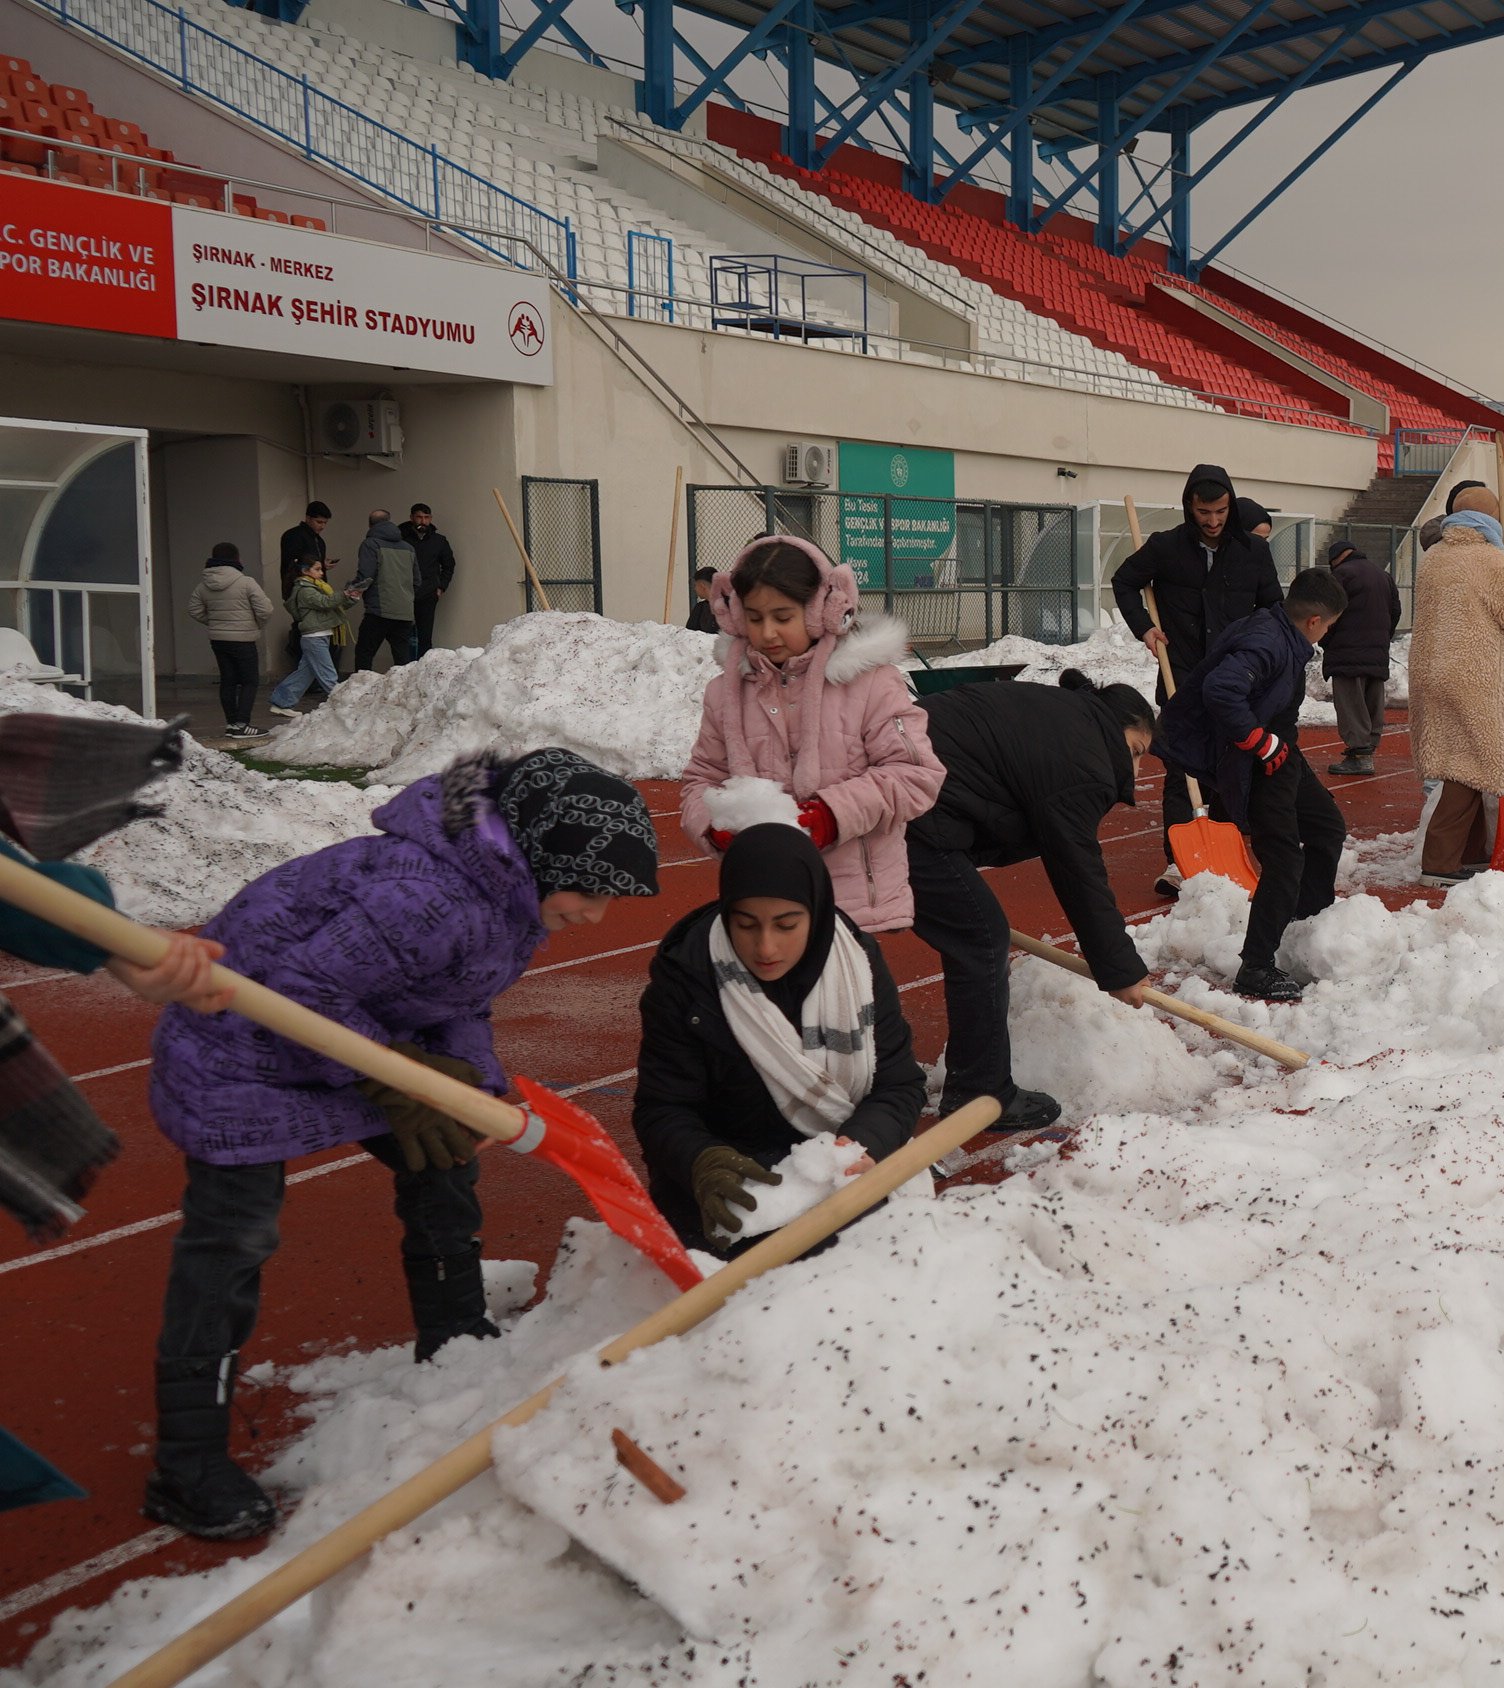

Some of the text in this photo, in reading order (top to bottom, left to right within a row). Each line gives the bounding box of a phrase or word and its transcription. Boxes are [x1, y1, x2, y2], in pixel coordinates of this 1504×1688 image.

[30, 228, 122, 260] GENÇLİK
[128, 244, 154, 265] VE
[192, 243, 256, 268] ŞIRNAK
[270, 256, 334, 281] MERKEZ
[48, 258, 156, 292] BAKANLIĞI
[191, 282, 475, 345] ŞIRNAK ŞEHİR STADYUMU
